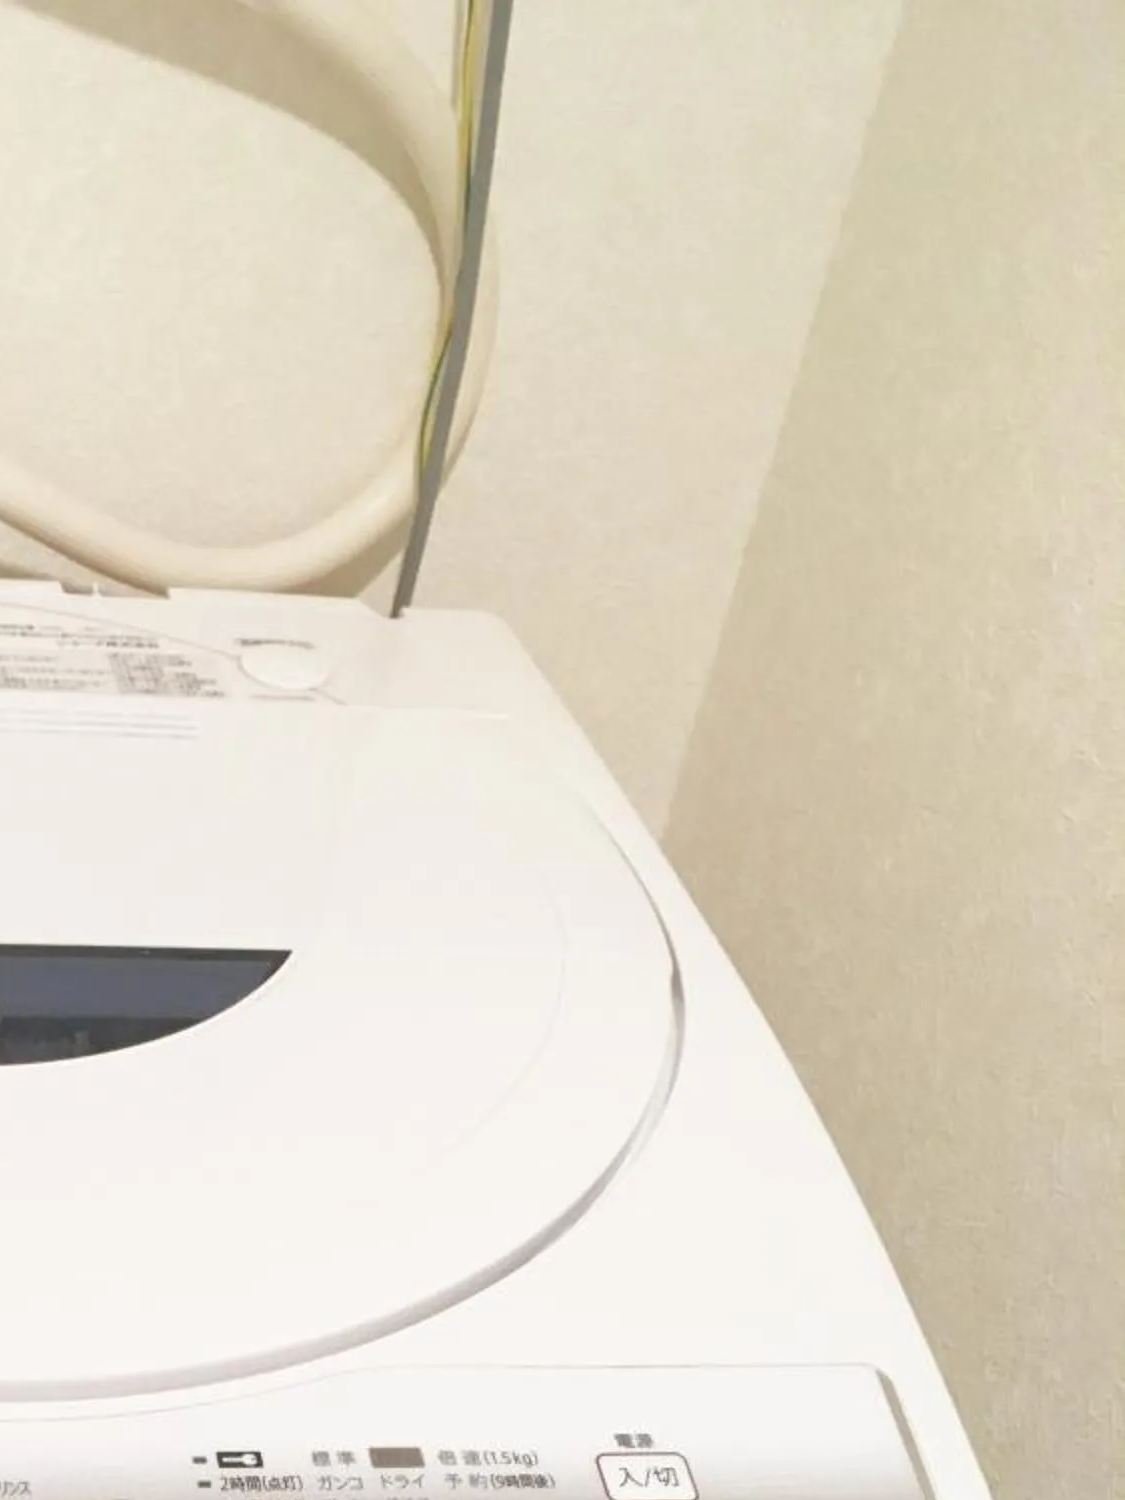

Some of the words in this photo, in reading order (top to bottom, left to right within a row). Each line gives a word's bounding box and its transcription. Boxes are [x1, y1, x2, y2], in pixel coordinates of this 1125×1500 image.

[318, 1475, 364, 1491] ガンコ
[380, 1474, 425, 1490] ドライ
